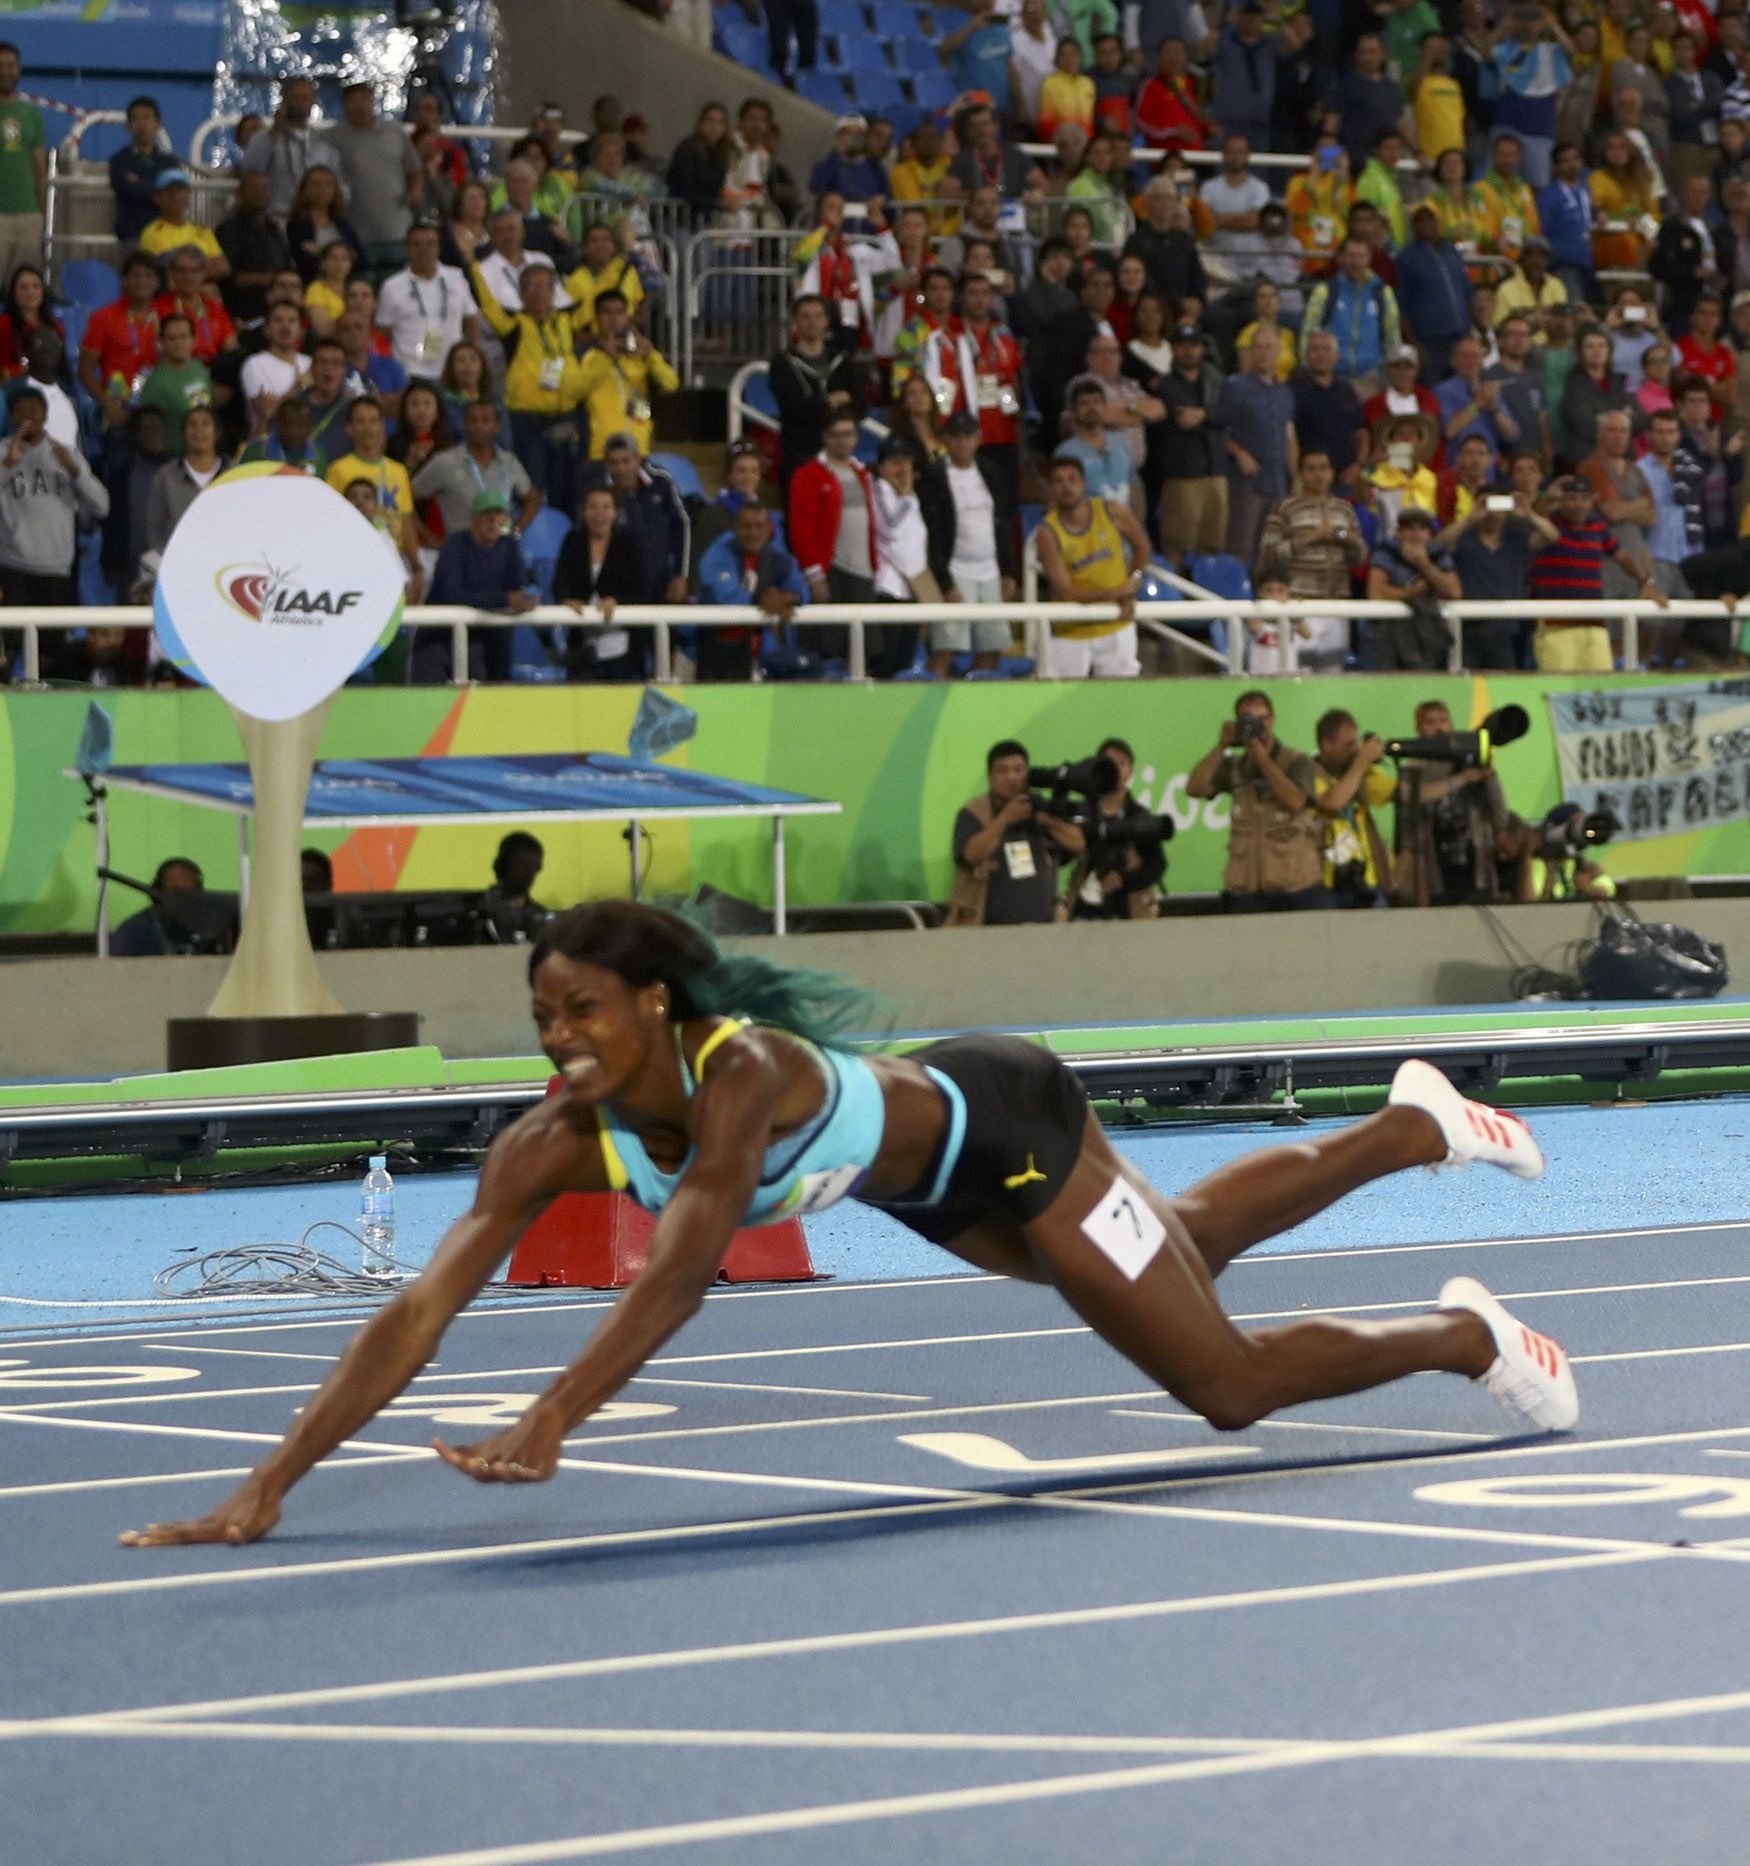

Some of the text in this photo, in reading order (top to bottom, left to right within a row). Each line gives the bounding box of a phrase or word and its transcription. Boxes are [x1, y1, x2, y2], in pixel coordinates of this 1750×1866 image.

[273, 588, 363, 615] IAAF
[1112, 1198, 1142, 1240] 7
[896, 1431, 1263, 1472] 7
